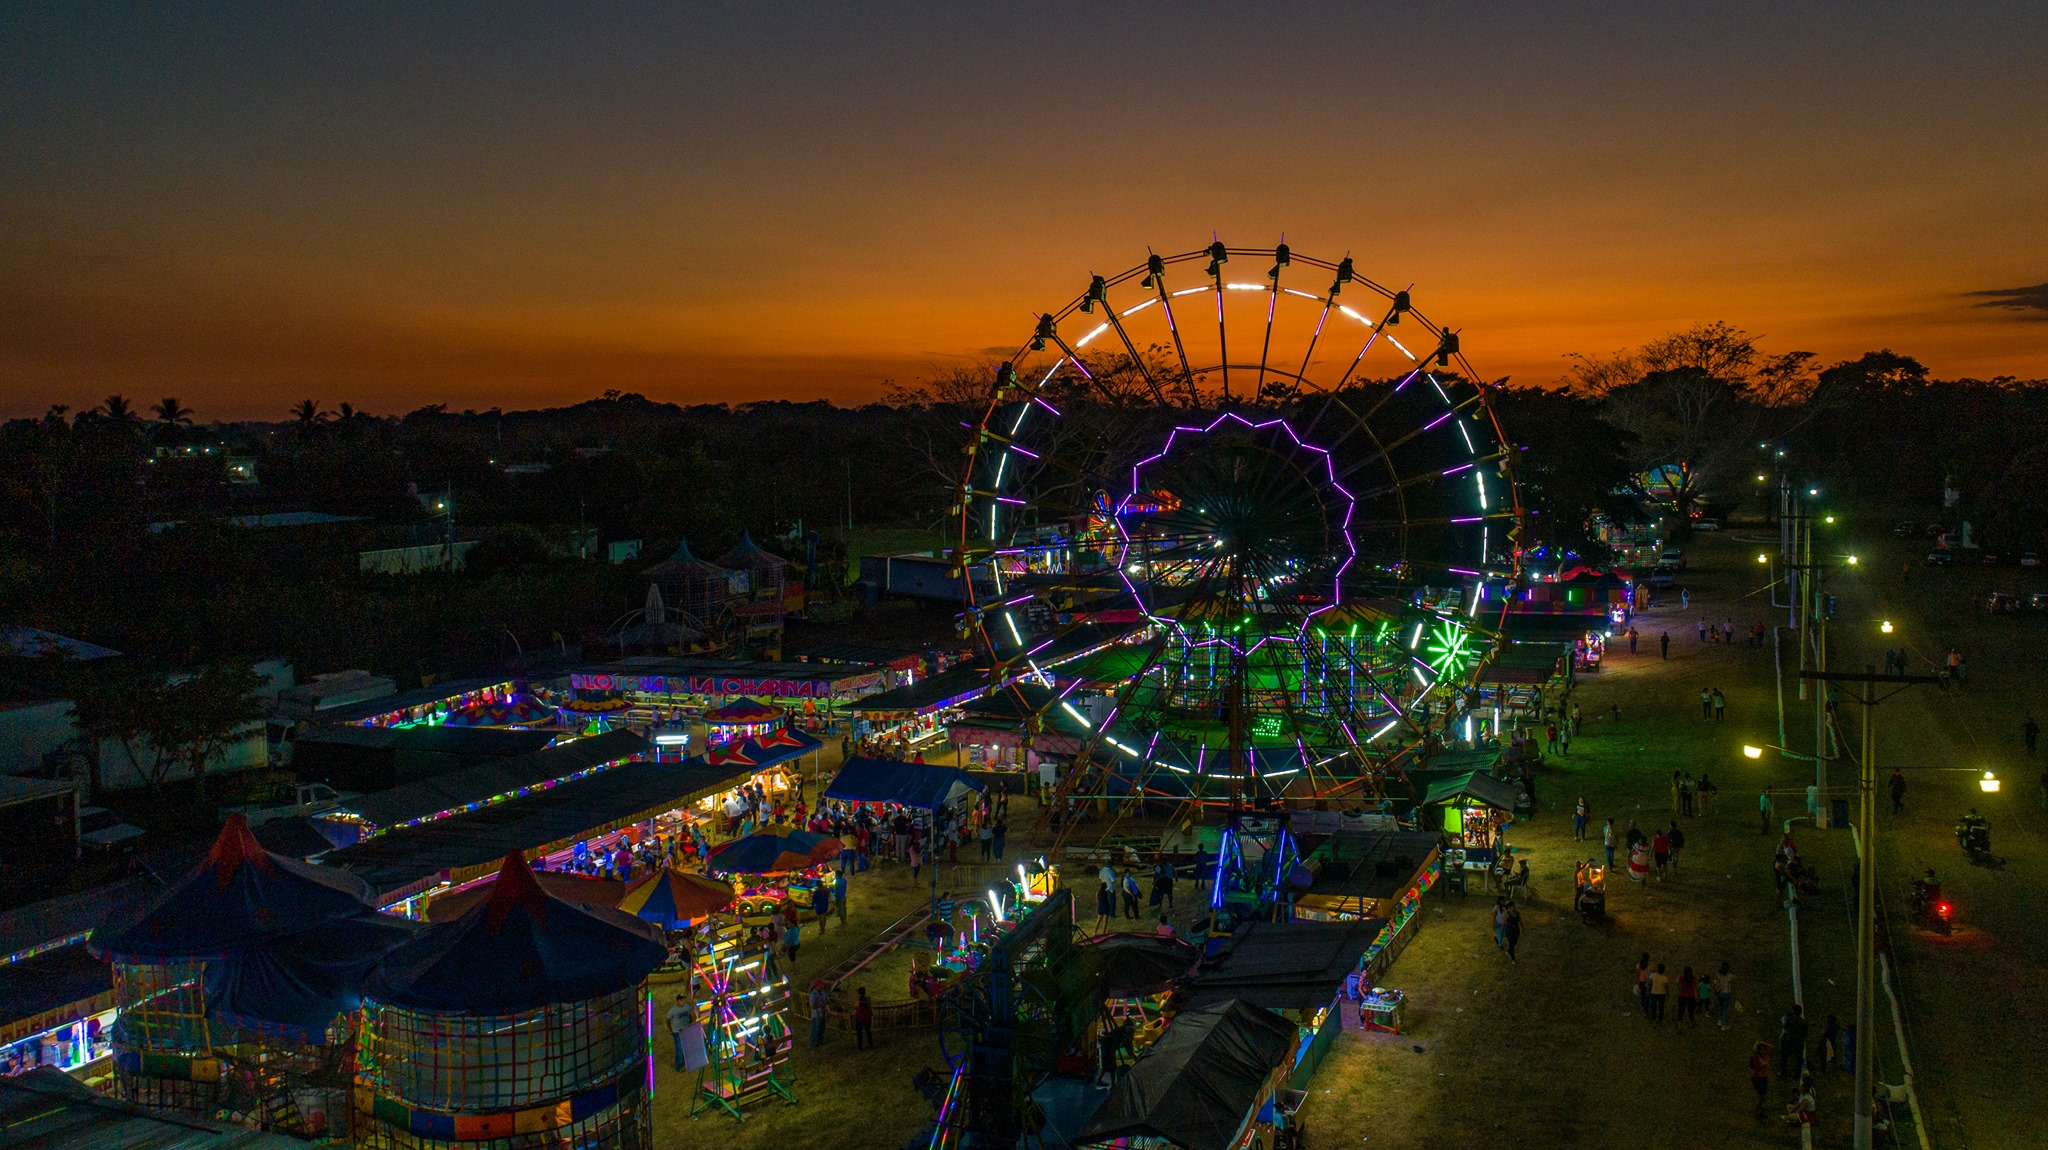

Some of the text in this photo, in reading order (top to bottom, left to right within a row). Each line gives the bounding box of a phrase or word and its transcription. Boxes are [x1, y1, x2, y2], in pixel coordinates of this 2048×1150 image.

[584, 674, 663, 692] LOTERIA
[690, 677, 714, 694] LA
[721, 678, 813, 697] CHAPINA
